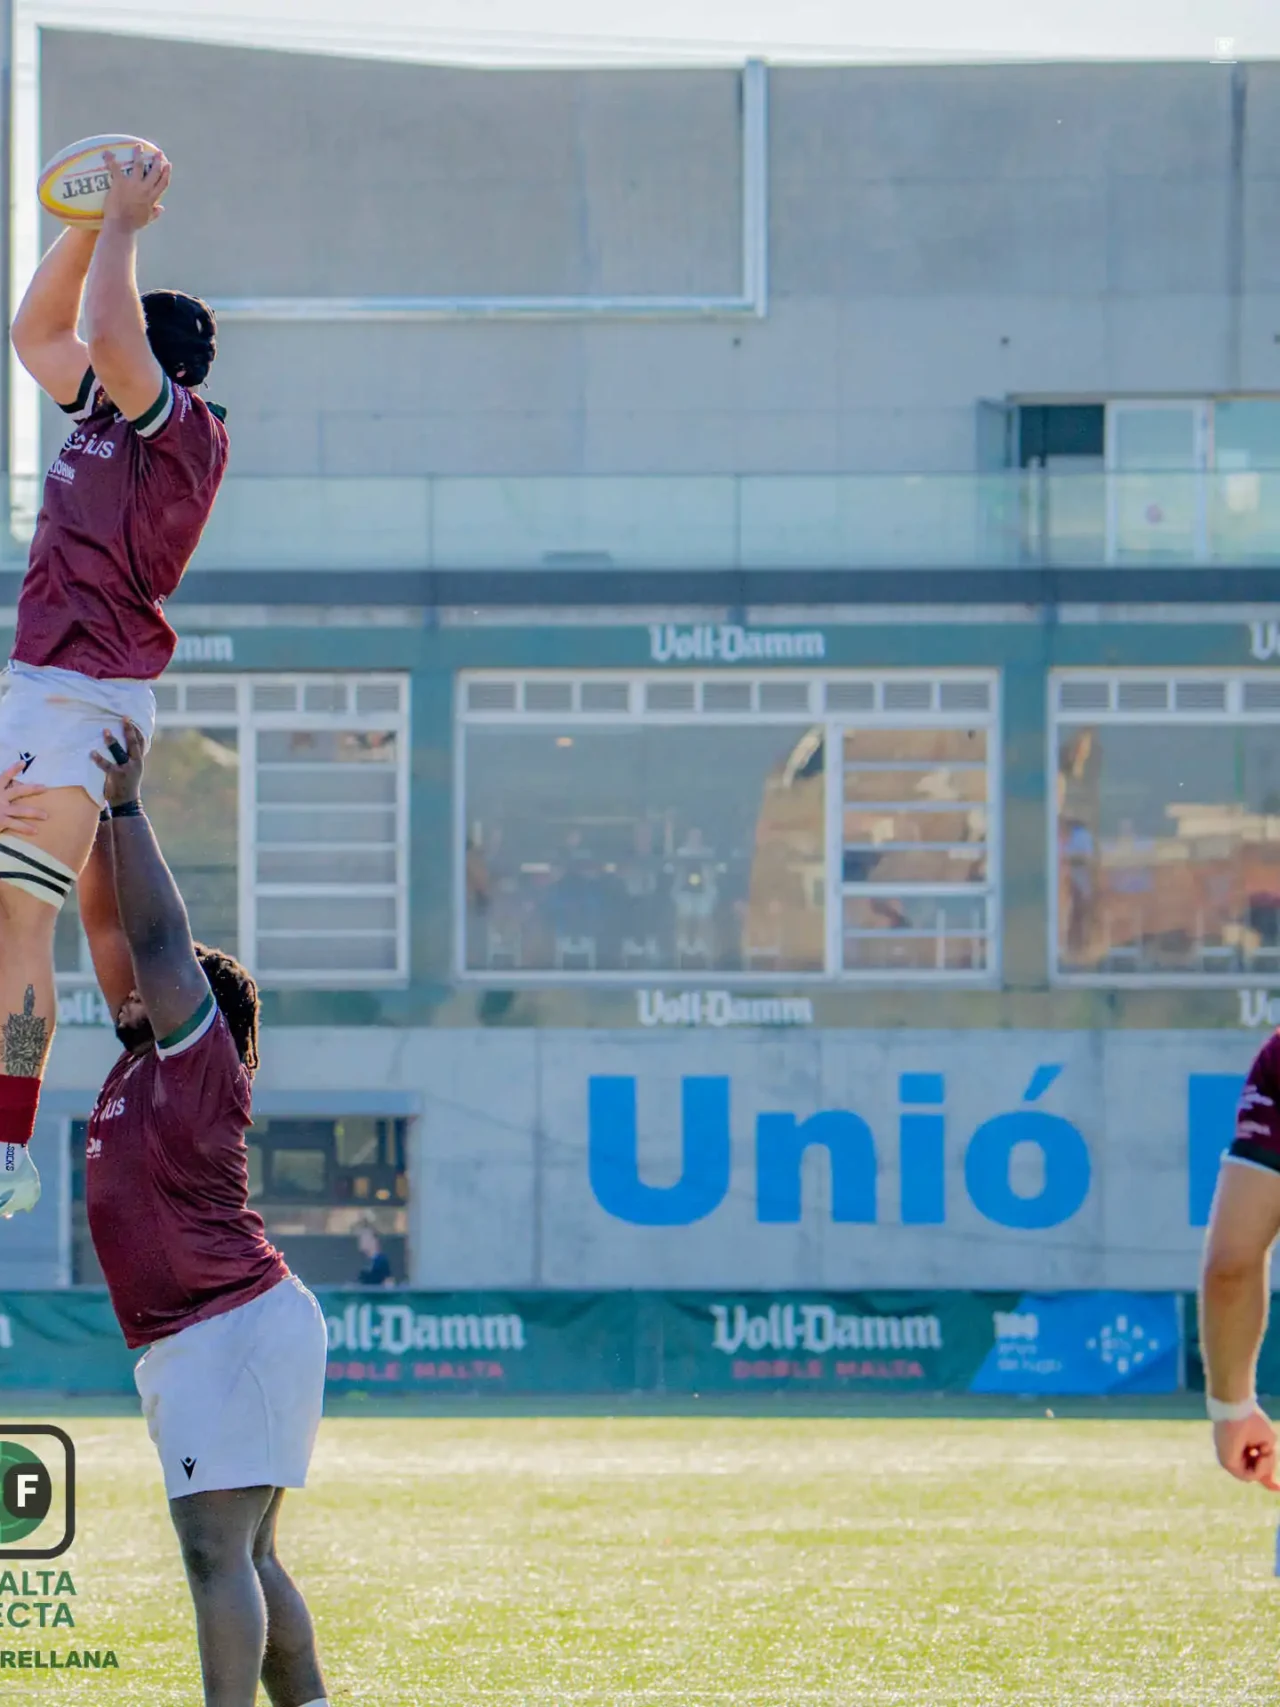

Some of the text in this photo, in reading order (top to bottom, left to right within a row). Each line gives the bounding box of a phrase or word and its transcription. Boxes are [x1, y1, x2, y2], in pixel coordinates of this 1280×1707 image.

[63, 172, 112, 199] ERT
[649, 623, 825, 662] Voll-Damm
[637, 988, 814, 1027] Voll-Damm
[6, 1143, 15, 1171] SOCKS
[588, 1064, 1091, 1228] Unió
[327, 1303, 526, 1354] oll-Damm
[709, 1303, 943, 1354] Voll-Damm
[327, 1361, 400, 1380] OBLE
